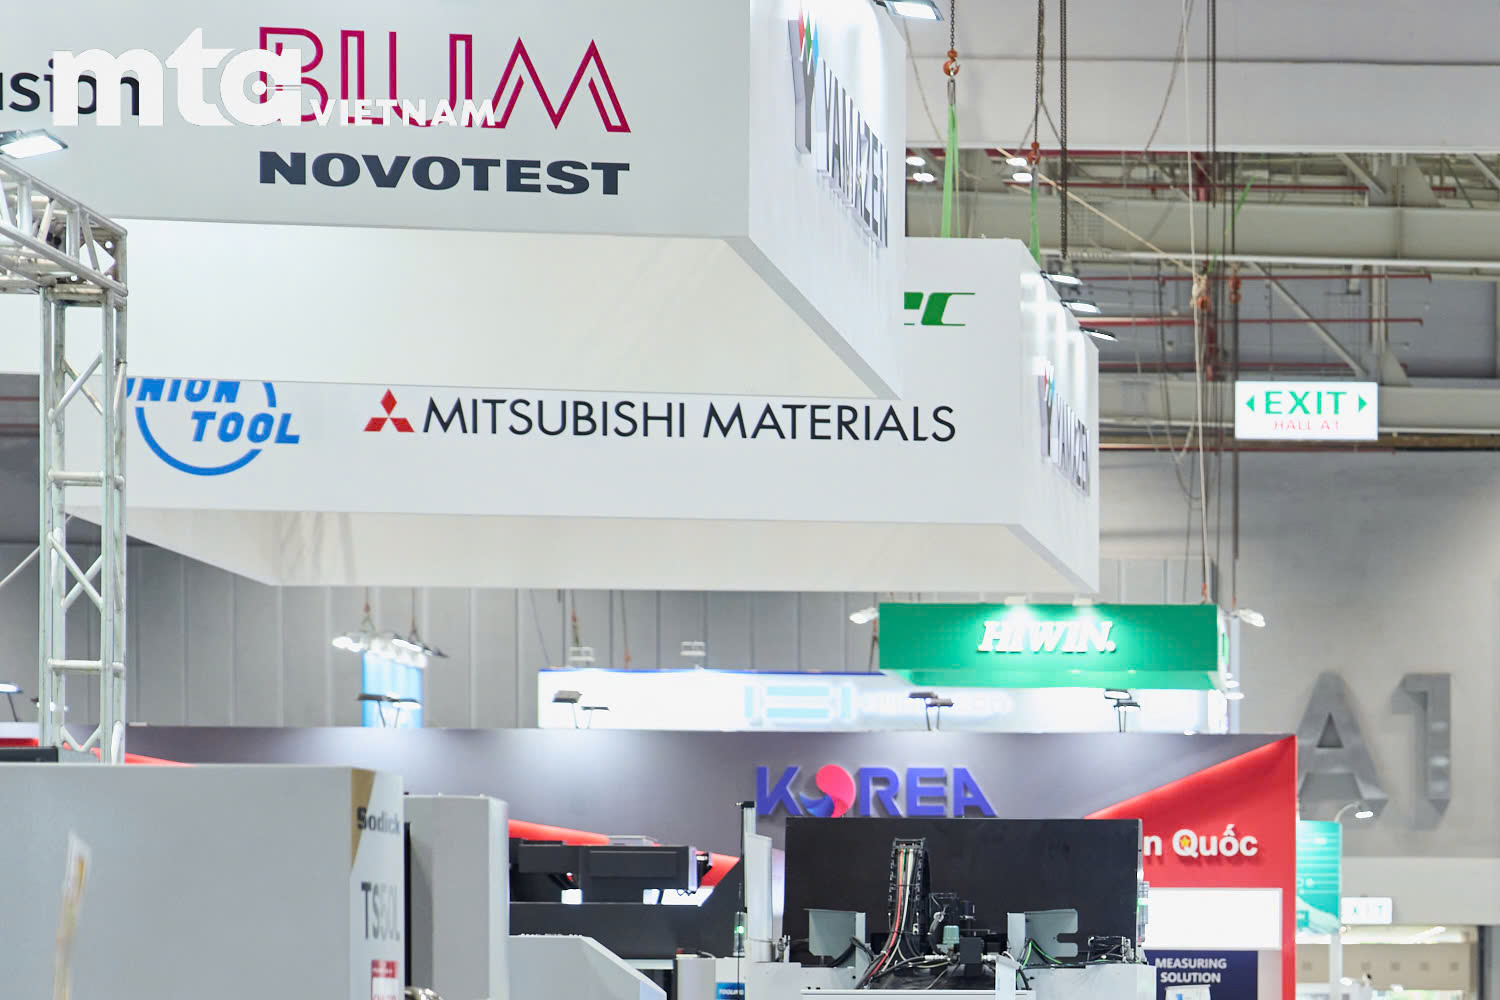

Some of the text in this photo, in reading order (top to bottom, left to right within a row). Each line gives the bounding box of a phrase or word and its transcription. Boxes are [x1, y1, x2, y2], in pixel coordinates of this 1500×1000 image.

[259, 151, 631, 195] NOVOTEST
[423, 397, 957, 443] MITSUBISHI MATERIALS
[1264, 391, 1347, 415] EXIT
[191, 411, 300, 444] TOOL
[1274, 420, 1340, 431] HALL A1
[1297, 671, 1451, 832] A1
[755, 764, 999, 817] KOREA
[1172, 823, 1259, 858] Quốc
[1155, 958, 1228, 970] MEASURING
[1160, 972, 1221, 983] SOLUTION
